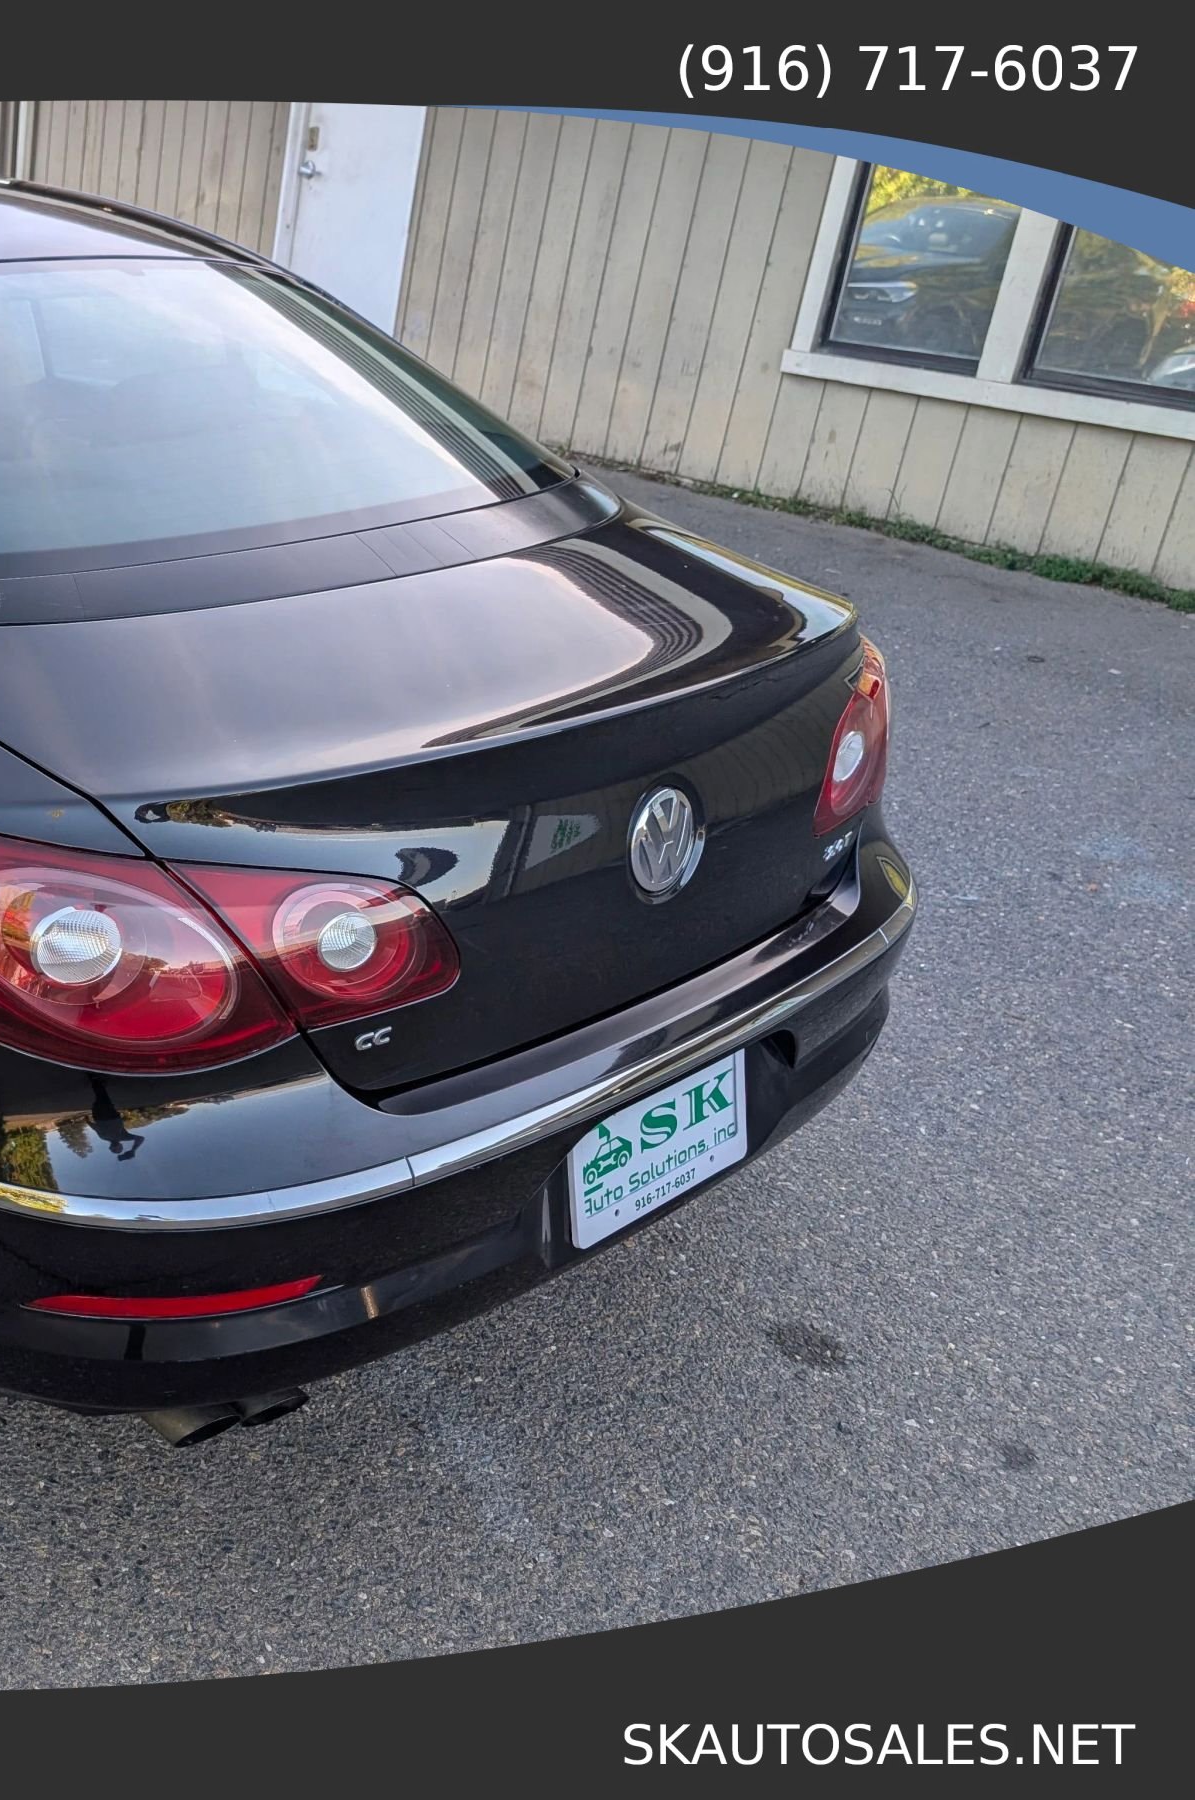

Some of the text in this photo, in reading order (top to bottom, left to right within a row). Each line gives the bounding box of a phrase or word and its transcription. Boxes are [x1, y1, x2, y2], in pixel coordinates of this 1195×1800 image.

[355, 1026, 392, 1051] CC
[640, 1068, 733, 1154] SK
[629, 1139, 709, 1192] Solutions,
[635, 1168, 696, 1211] 916-717-6037
